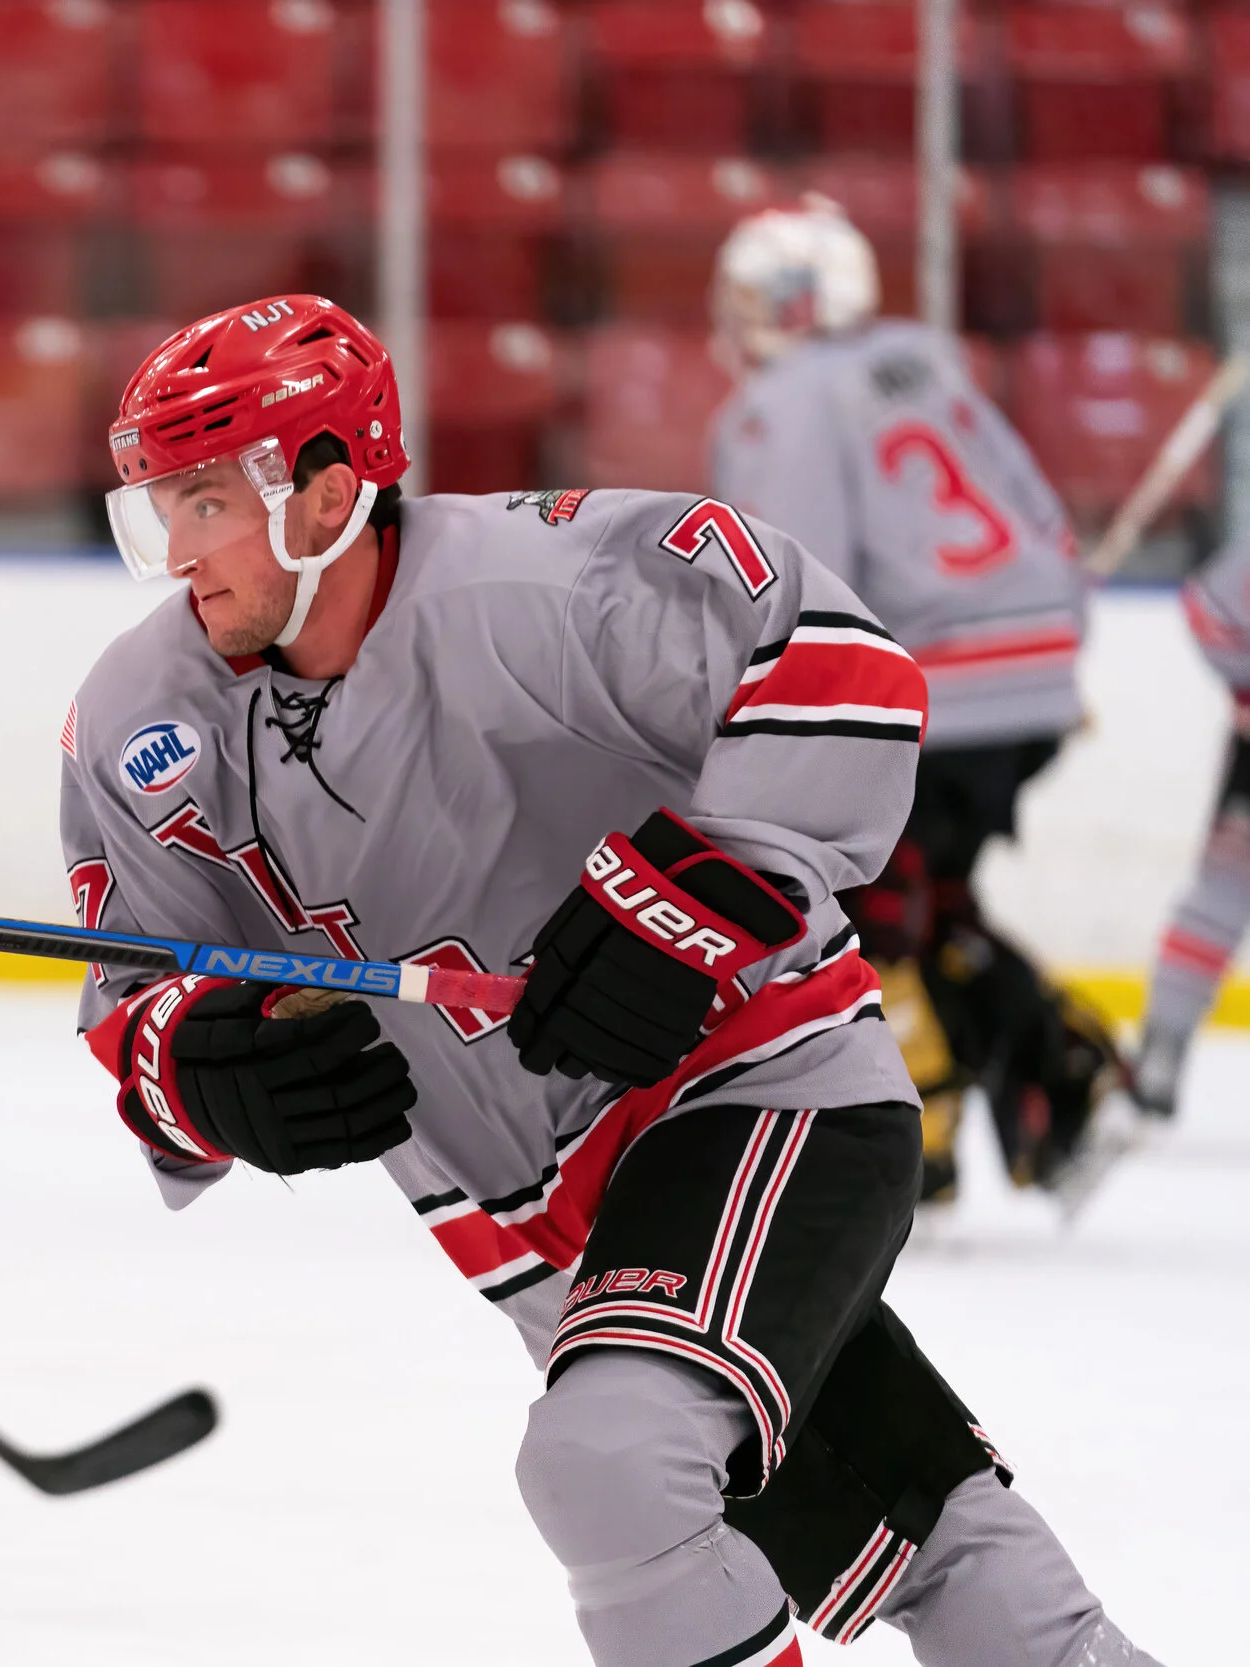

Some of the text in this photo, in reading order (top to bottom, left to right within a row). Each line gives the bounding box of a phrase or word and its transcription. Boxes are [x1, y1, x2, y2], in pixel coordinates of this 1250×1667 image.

[240, 299, 296, 332] NJT
[659, 497, 778, 602] 7
[124, 730, 197, 790] NAHL
[67, 856, 117, 990] 7
[585, 836, 737, 967] AUER
[205, 950, 400, 991] NEXUS
